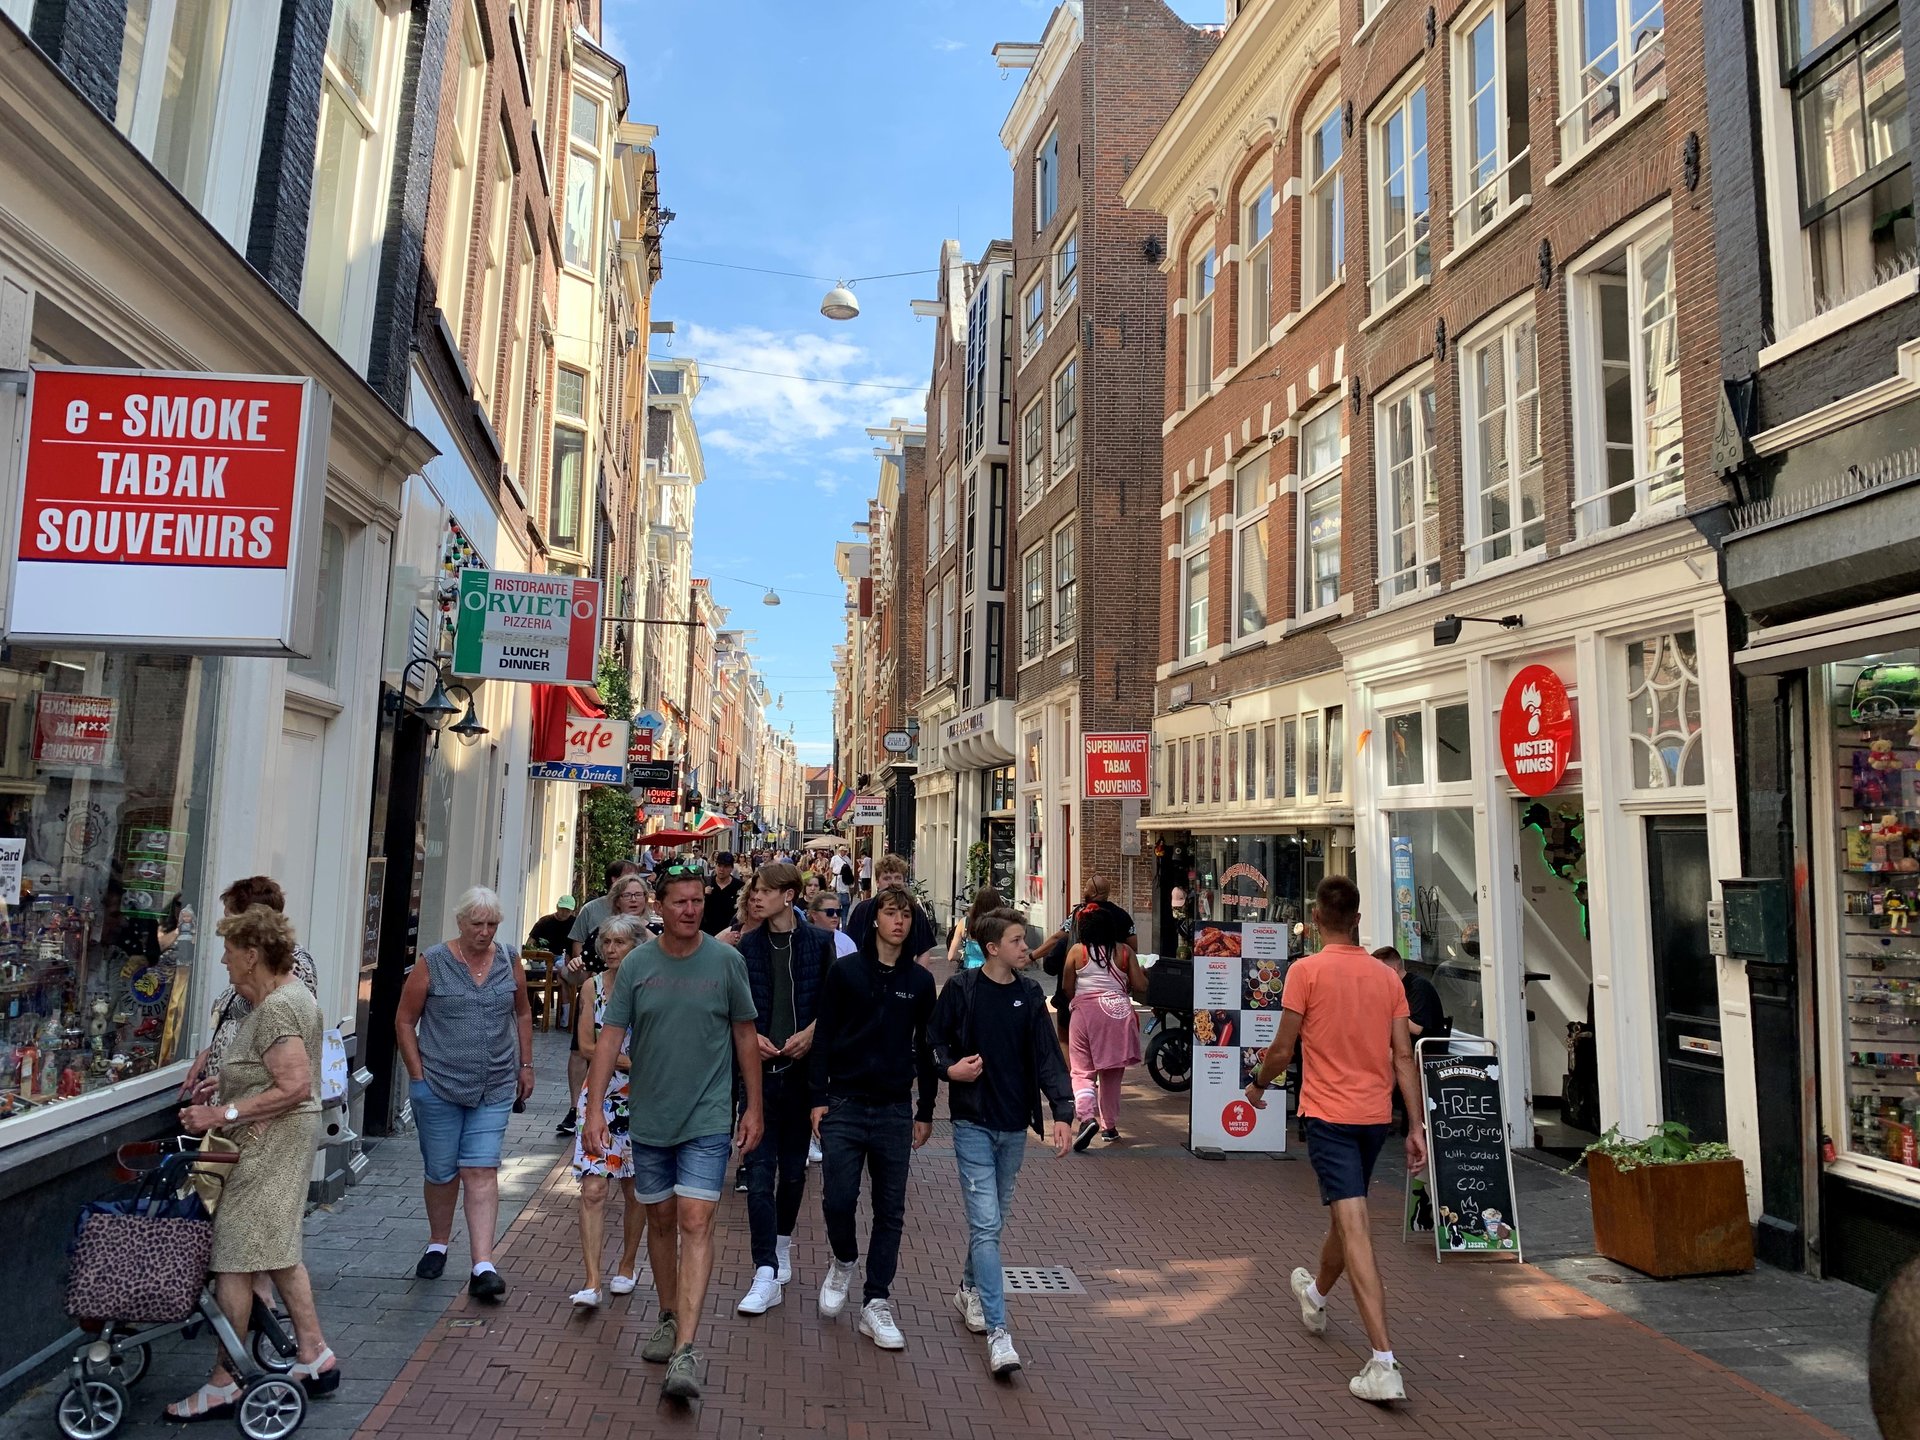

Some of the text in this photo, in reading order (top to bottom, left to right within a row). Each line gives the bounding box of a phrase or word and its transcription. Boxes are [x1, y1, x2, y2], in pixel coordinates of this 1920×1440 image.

[65, 399, 90, 435] e
[122, 394, 270, 442] SMOKE
[97, 451, 229, 499] TABAK
[36, 507, 275, 560] SOUVENIRS
[494, 578, 568, 596] RISTORANTE
[463, 590, 594, 619] ORVIETO
[503, 615, 552, 631] PIZZERIA
[502, 646, 549, 659] LUNCH
[499, 658, 550, 671] DINNER
[634, 729, 650, 737] NE
[1086, 739, 1147, 754] SUPERMARKET
[1514, 739, 1554, 757] MISTER
[628, 754, 648, 762] ORE
[1103, 759, 1131, 773] TABAK
[1515, 757, 1553, 774] WINGS
[538, 766, 618, 781] Food & Drinks
[634, 769, 651, 777] CIAO
[1094, 779, 1142, 793] SOUVENIRS
[647, 789, 676, 798] LOUNGE
[651, 797, 671, 805] CAFE
[1439, 1087, 1497, 1115] FREE
[1470, 1151, 1500, 1160] orders
[1458, 1162, 1484, 1172] above
